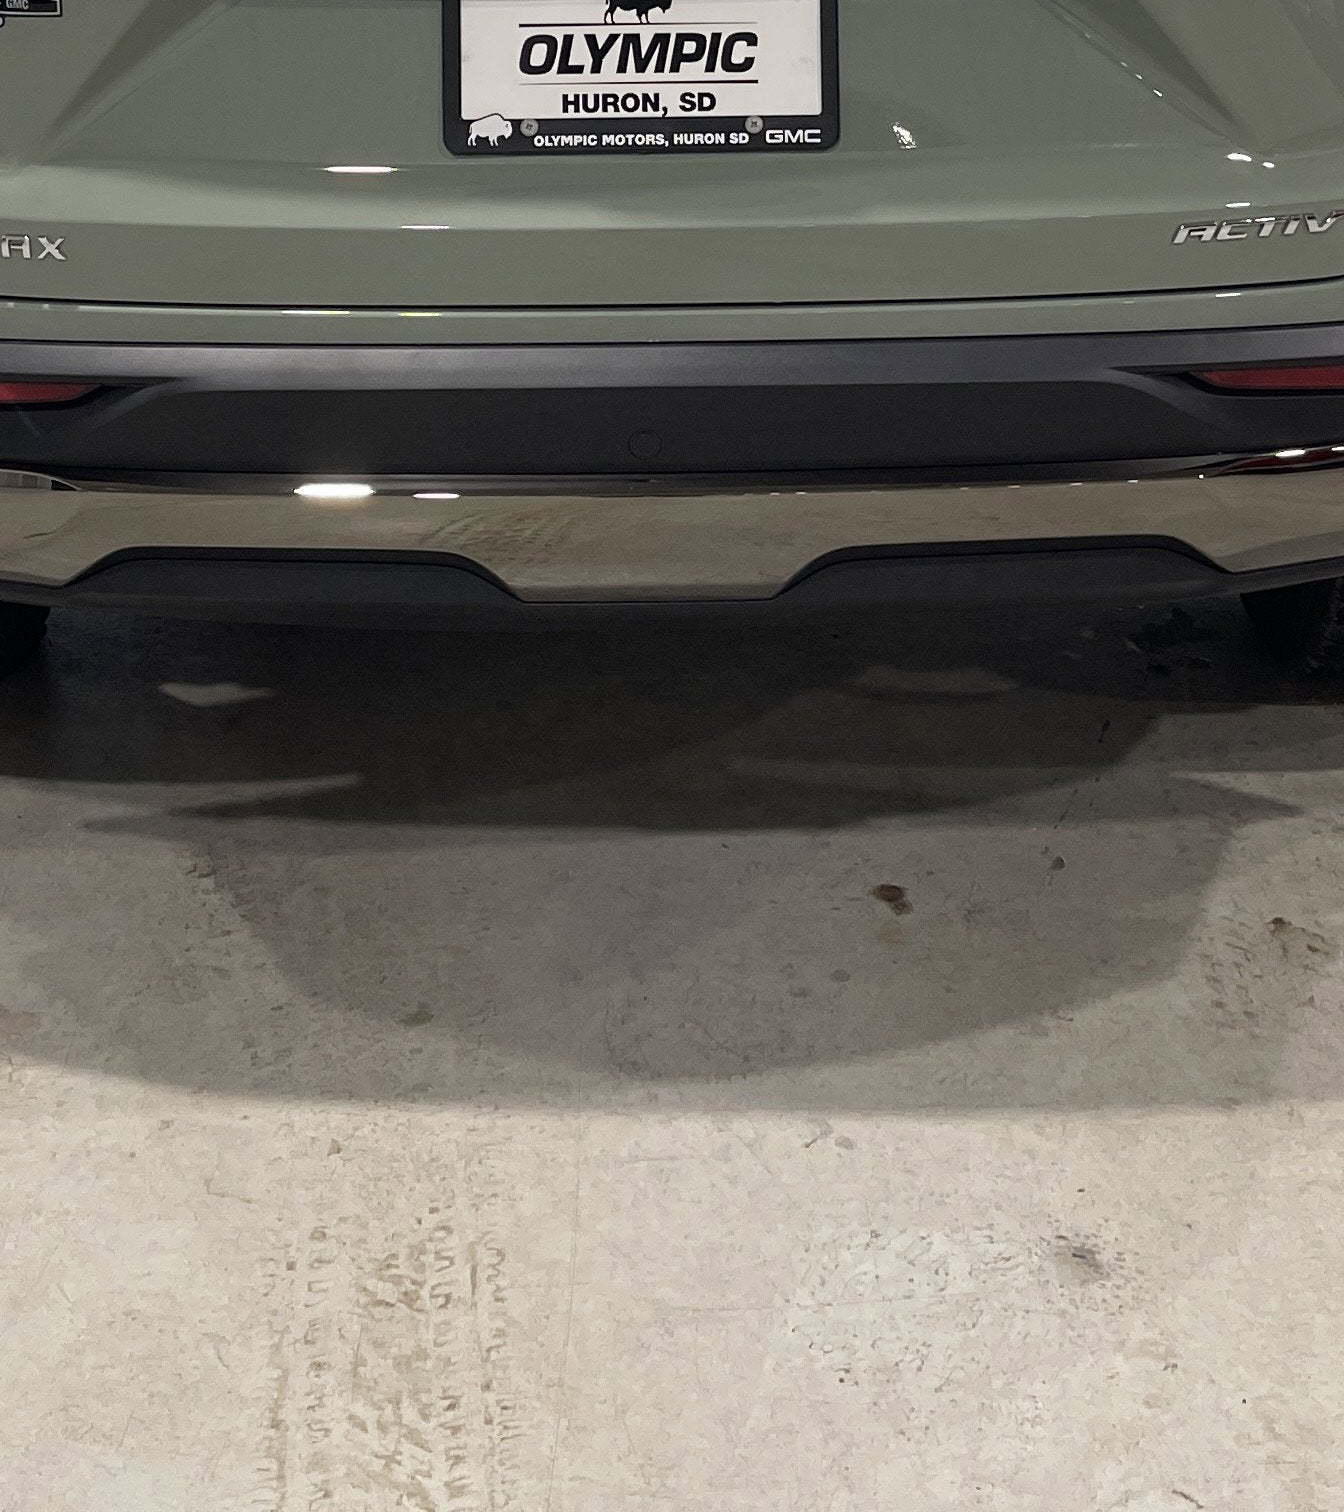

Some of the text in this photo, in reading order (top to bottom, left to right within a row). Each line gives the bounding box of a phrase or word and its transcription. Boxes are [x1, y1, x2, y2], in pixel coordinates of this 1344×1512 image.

[518, 31, 759, 76] OLYMPIC
[561, 92, 717, 118] HURON, SD
[533, 131, 750, 148] OLYMPIC MOTORS, HURON SD
[765, 128, 822, 144] GMC
